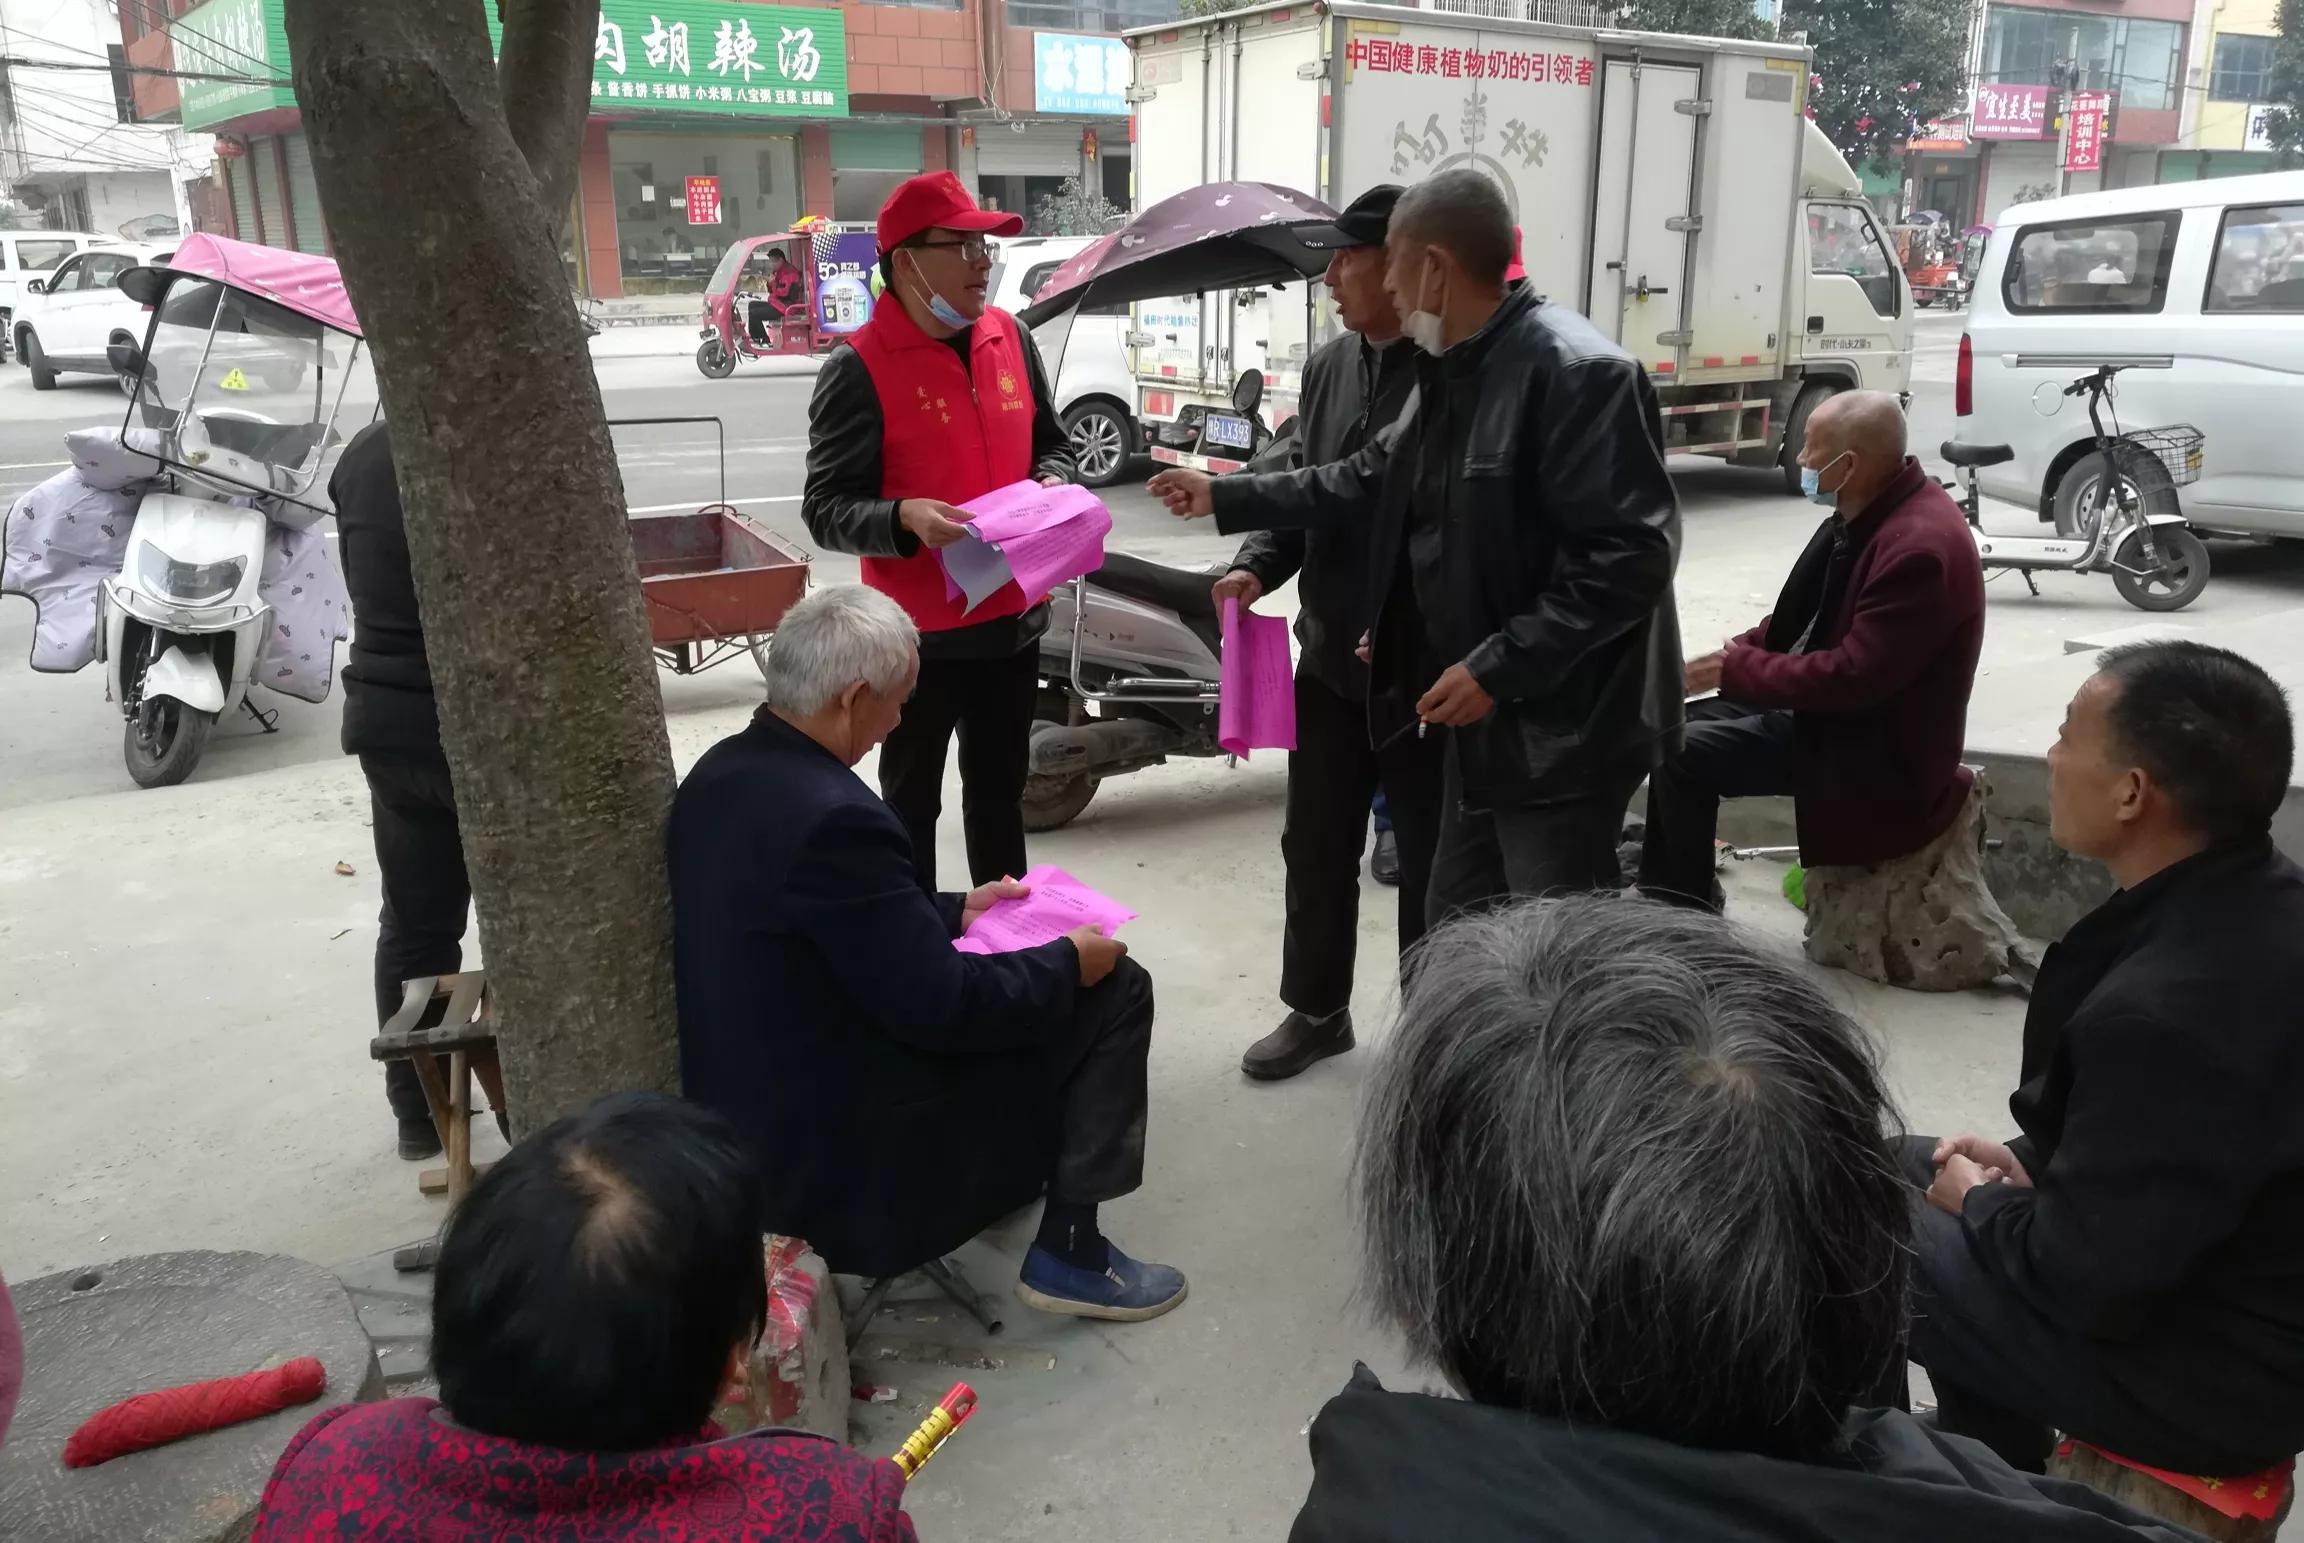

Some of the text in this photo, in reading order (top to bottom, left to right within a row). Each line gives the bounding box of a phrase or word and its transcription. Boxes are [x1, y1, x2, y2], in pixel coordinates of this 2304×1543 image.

[1346, 38, 1596, 87] 中国健康植物奶的引领者
[695, 85, 732, 102] 小米粥
[736, 88, 772, 103] 八宝粥
[775, 90, 797, 105] 豆浆
[2074, 112, 2095, 165] 培训中心
